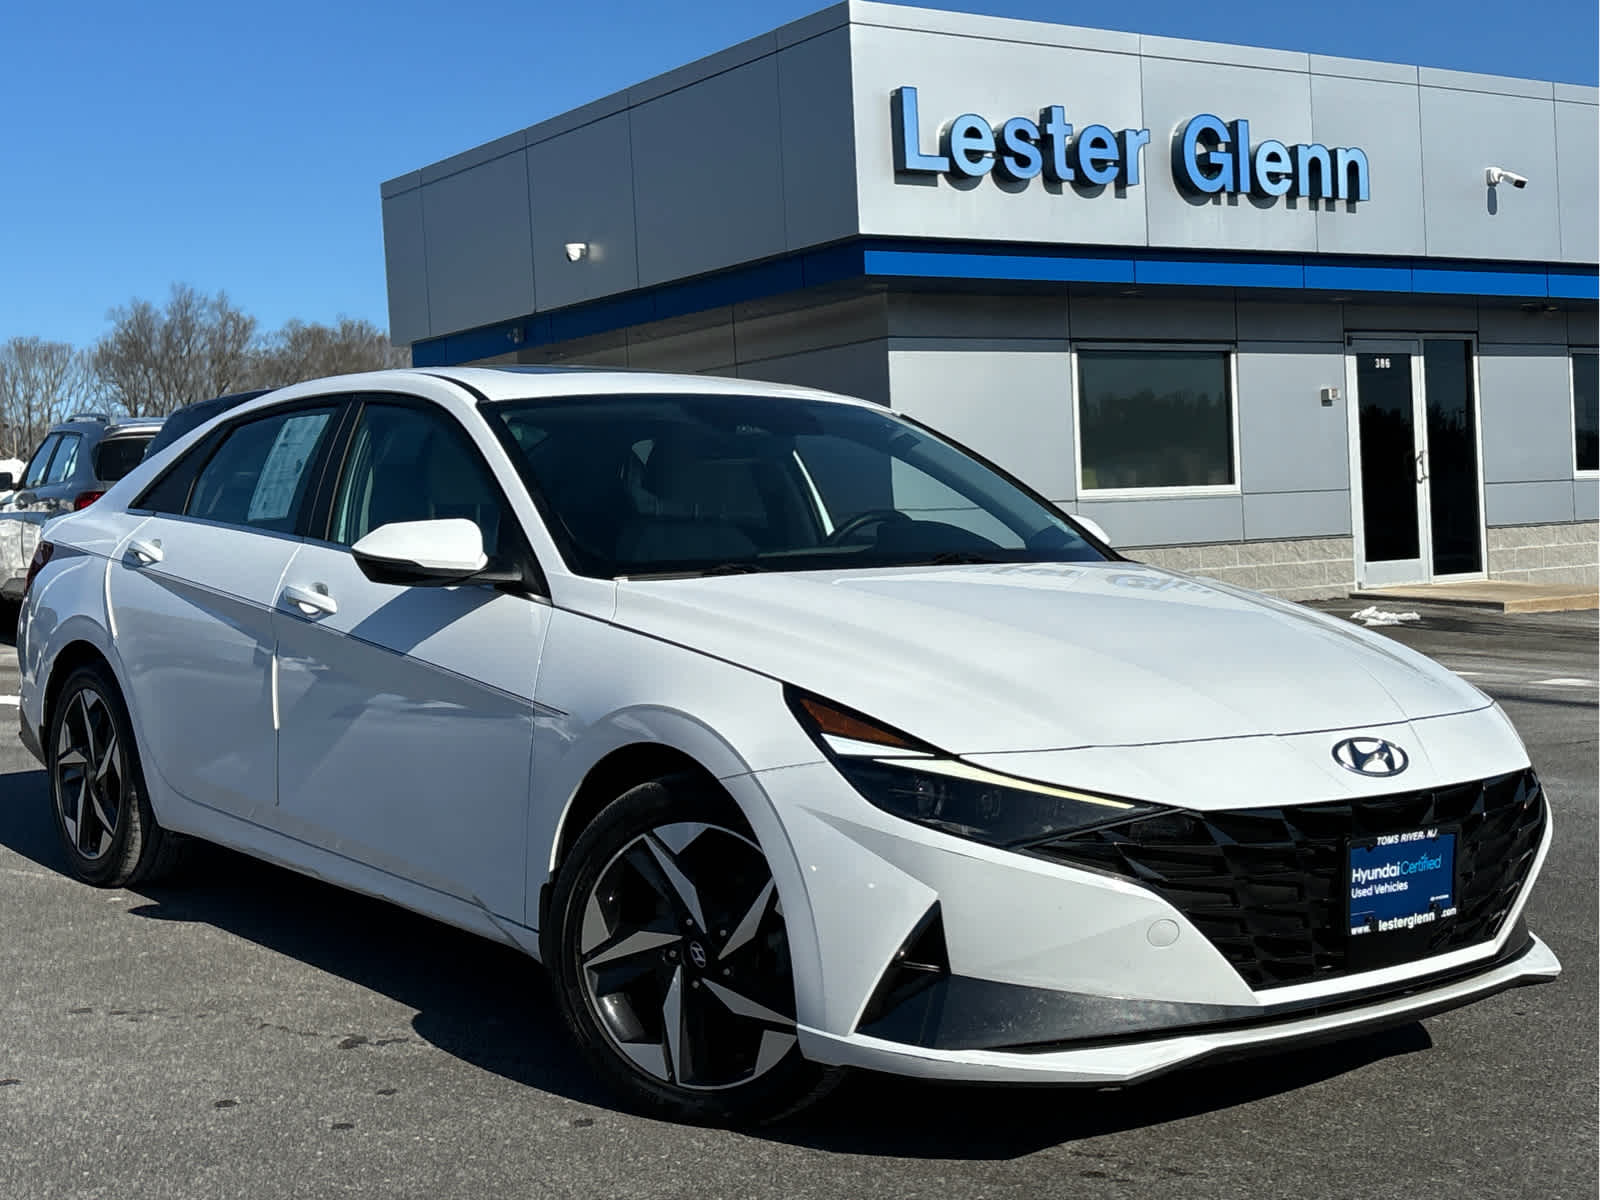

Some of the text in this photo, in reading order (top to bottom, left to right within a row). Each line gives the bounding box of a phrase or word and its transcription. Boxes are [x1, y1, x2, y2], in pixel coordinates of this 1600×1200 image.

[890, 86, 1371, 202] Lester Glenn
[1377, 834, 1399, 846] TOMS
[1427, 828, 1438, 839] NJ
[1352, 861, 1400, 885] Hyundai
[1351, 881, 1408, 898] Used Vehicles
[1378, 912, 1435, 931] lesterglenn
